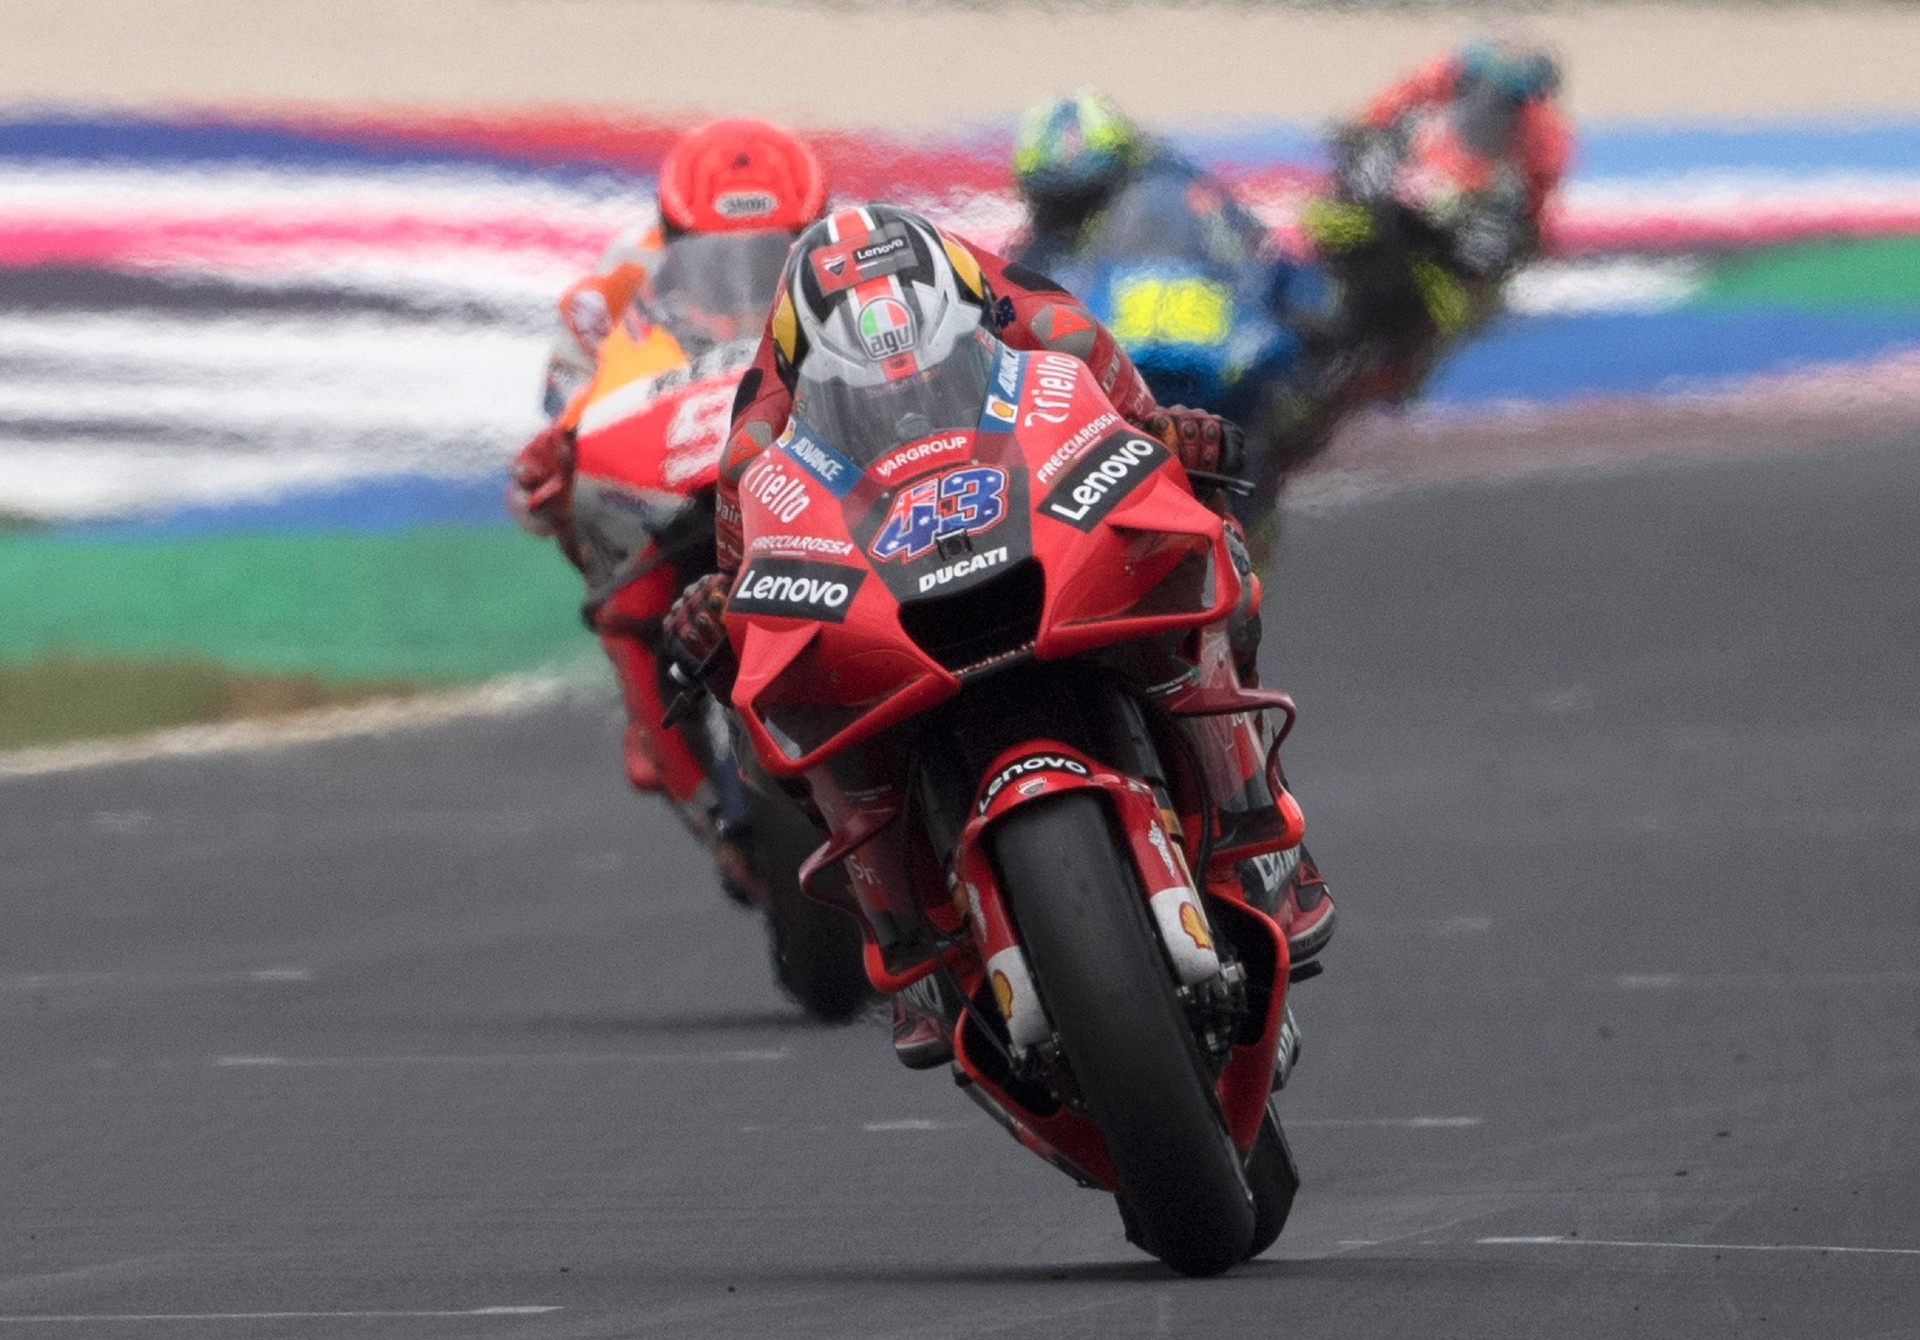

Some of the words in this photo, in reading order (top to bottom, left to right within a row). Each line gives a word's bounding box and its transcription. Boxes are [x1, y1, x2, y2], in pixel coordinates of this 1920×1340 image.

[857, 239, 904, 260] Lenovo
[870, 326, 911, 354] agv
[791, 437, 843, 481] ADVANCE
[876, 436, 968, 477] VARGROUP
[1037, 412, 1119, 485] FRECCIAROSSA
[1051, 439, 1155, 521] Lenovo
[869, 465, 1008, 562] 43
[736, 570, 849, 607] Lenovo
[919, 547, 1008, 592] DUCATI
[979, 757, 1087, 814] Lenovo
